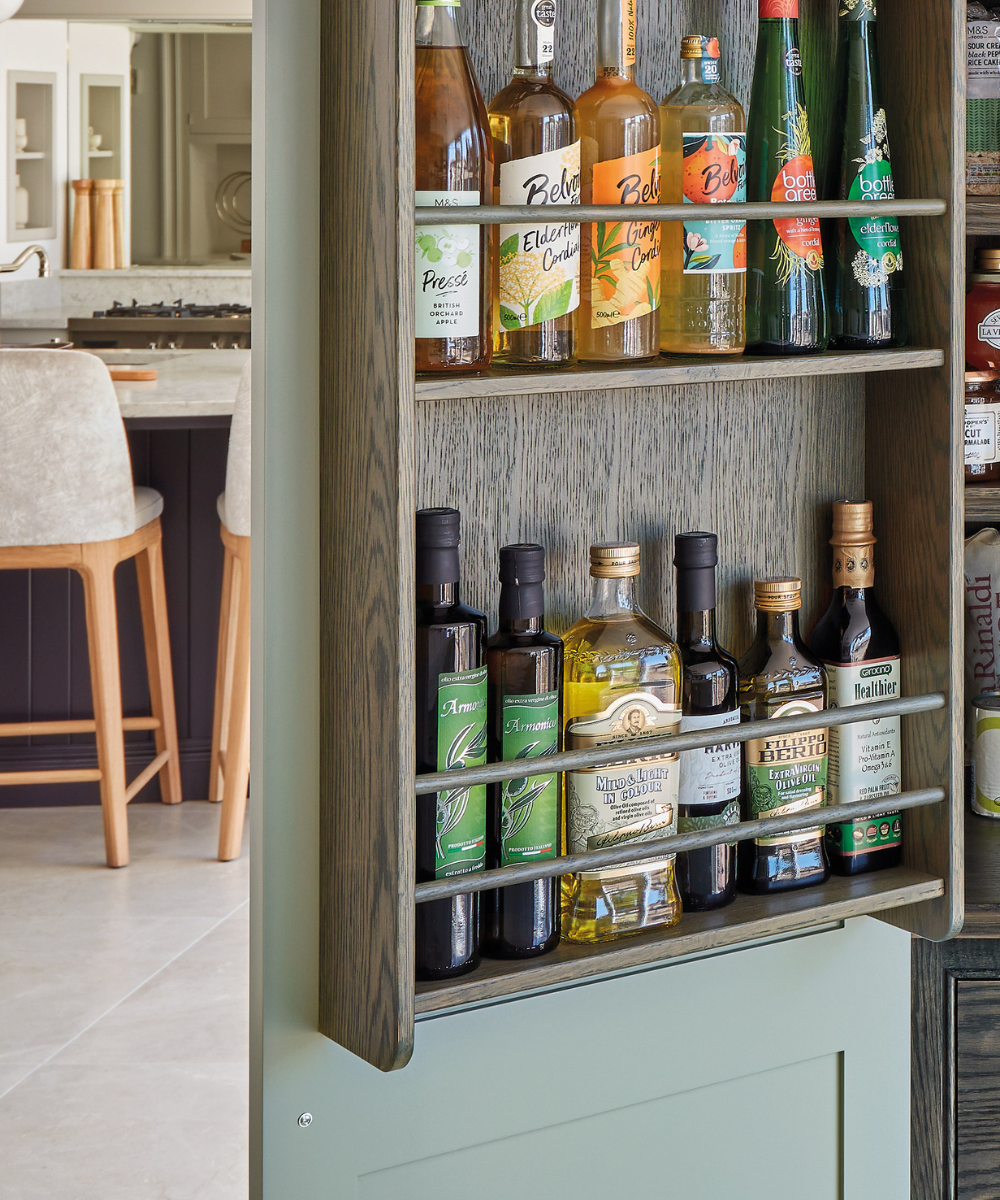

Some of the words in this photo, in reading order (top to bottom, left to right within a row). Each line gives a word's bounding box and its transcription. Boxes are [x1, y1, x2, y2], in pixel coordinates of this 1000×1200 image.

[968, 26, 988, 35] M&S
[542, 45, 553, 53] 22
[704, 65, 717, 73] 20
[522, 168, 580, 205] Belvoi
[627, 222, 660, 246] Ginge
[422, 269, 469, 292] Pressé
[966, 574, 996, 681] Rinaldi
[855, 679, 897, 700] Healthier
[505, 717, 557, 734] Armonico
[764, 734, 825, 749] FILIPPO
[862, 743, 885, 753] Vitamin
[758, 742, 826, 762] BERIO
[596, 776, 626, 791] MILD
[626, 774, 636, 786] &
[636, 768, 668, 783] LIGHT
[769, 768, 795, 780] EXTRA
[794, 764, 820, 774] VIRGIN
[776, 776, 801, 791] OLIVE
[802, 773, 816, 784] OIL
[603, 793, 615, 804] IN
[620, 781, 662, 801] COLOUR
